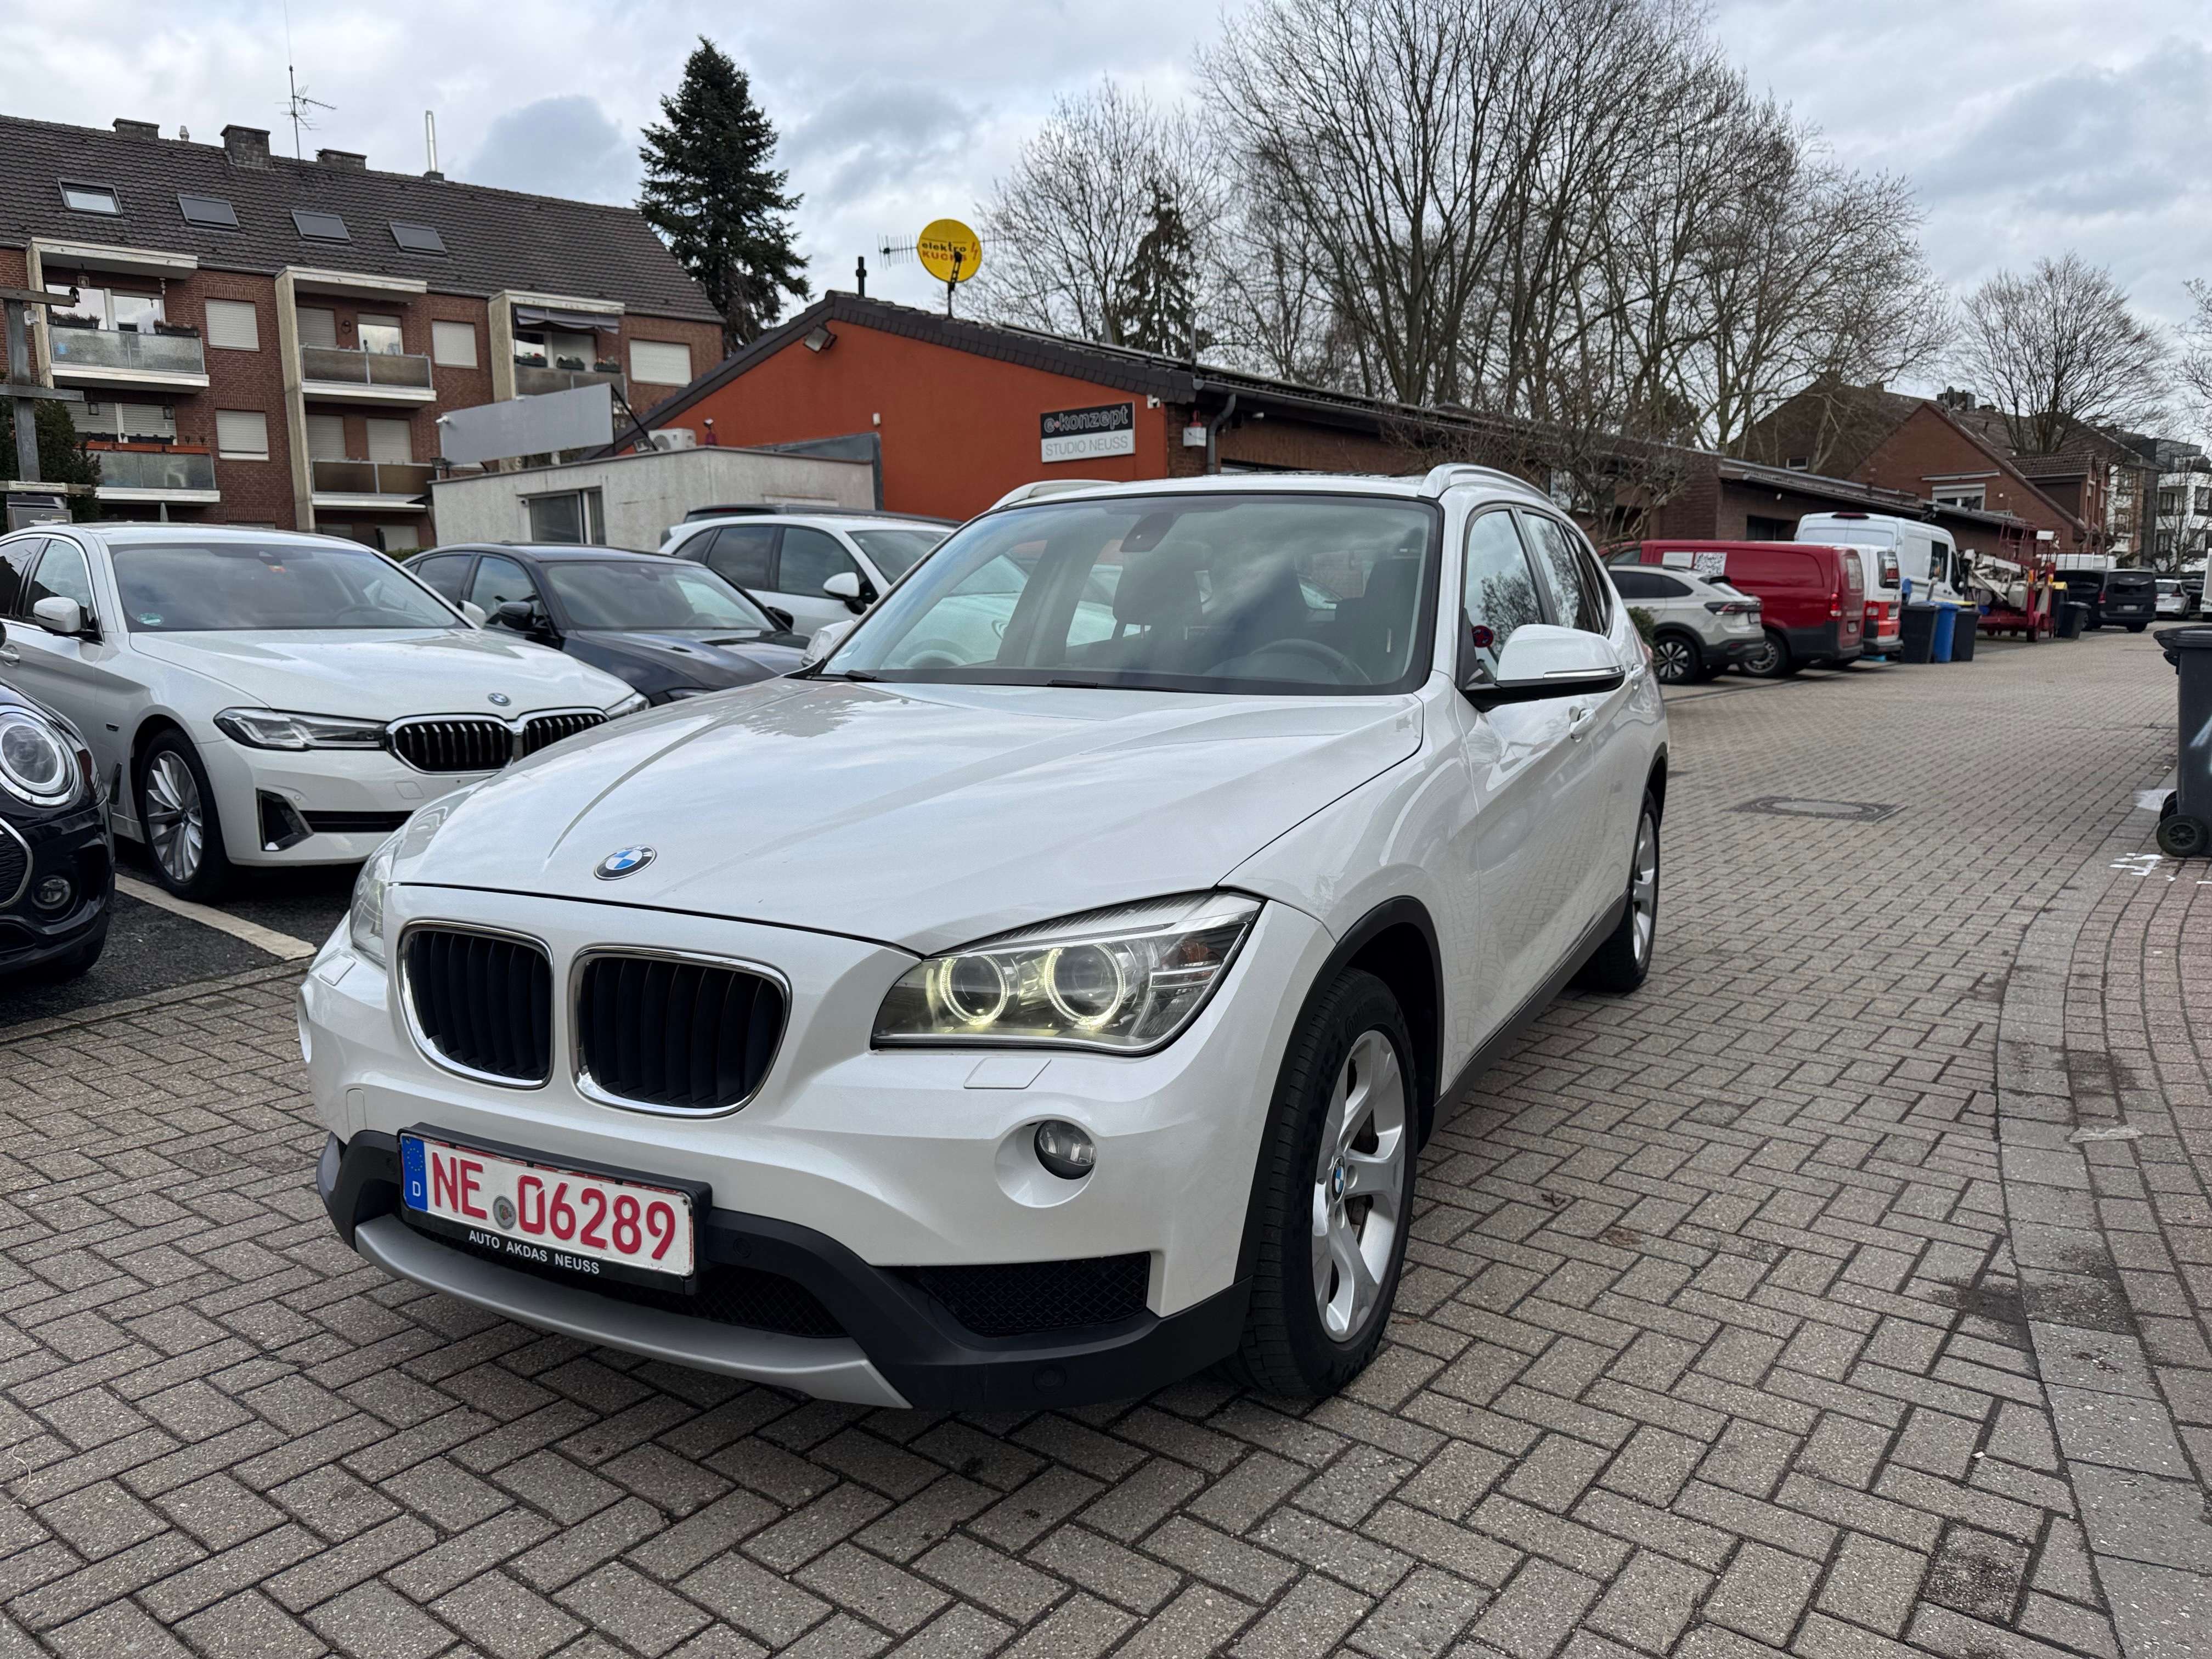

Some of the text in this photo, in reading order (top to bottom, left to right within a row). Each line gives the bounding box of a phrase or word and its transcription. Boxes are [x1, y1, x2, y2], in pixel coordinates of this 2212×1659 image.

[922, 241, 966, 252] elektro
[1046, 436, 1128, 456] STUDIO NEUSS
[413, 1181, 421, 1197] D
[432, 1152, 676, 1260] NE 06289
[469, 1230, 600, 1274] AUTO AKDAS NEUSS
